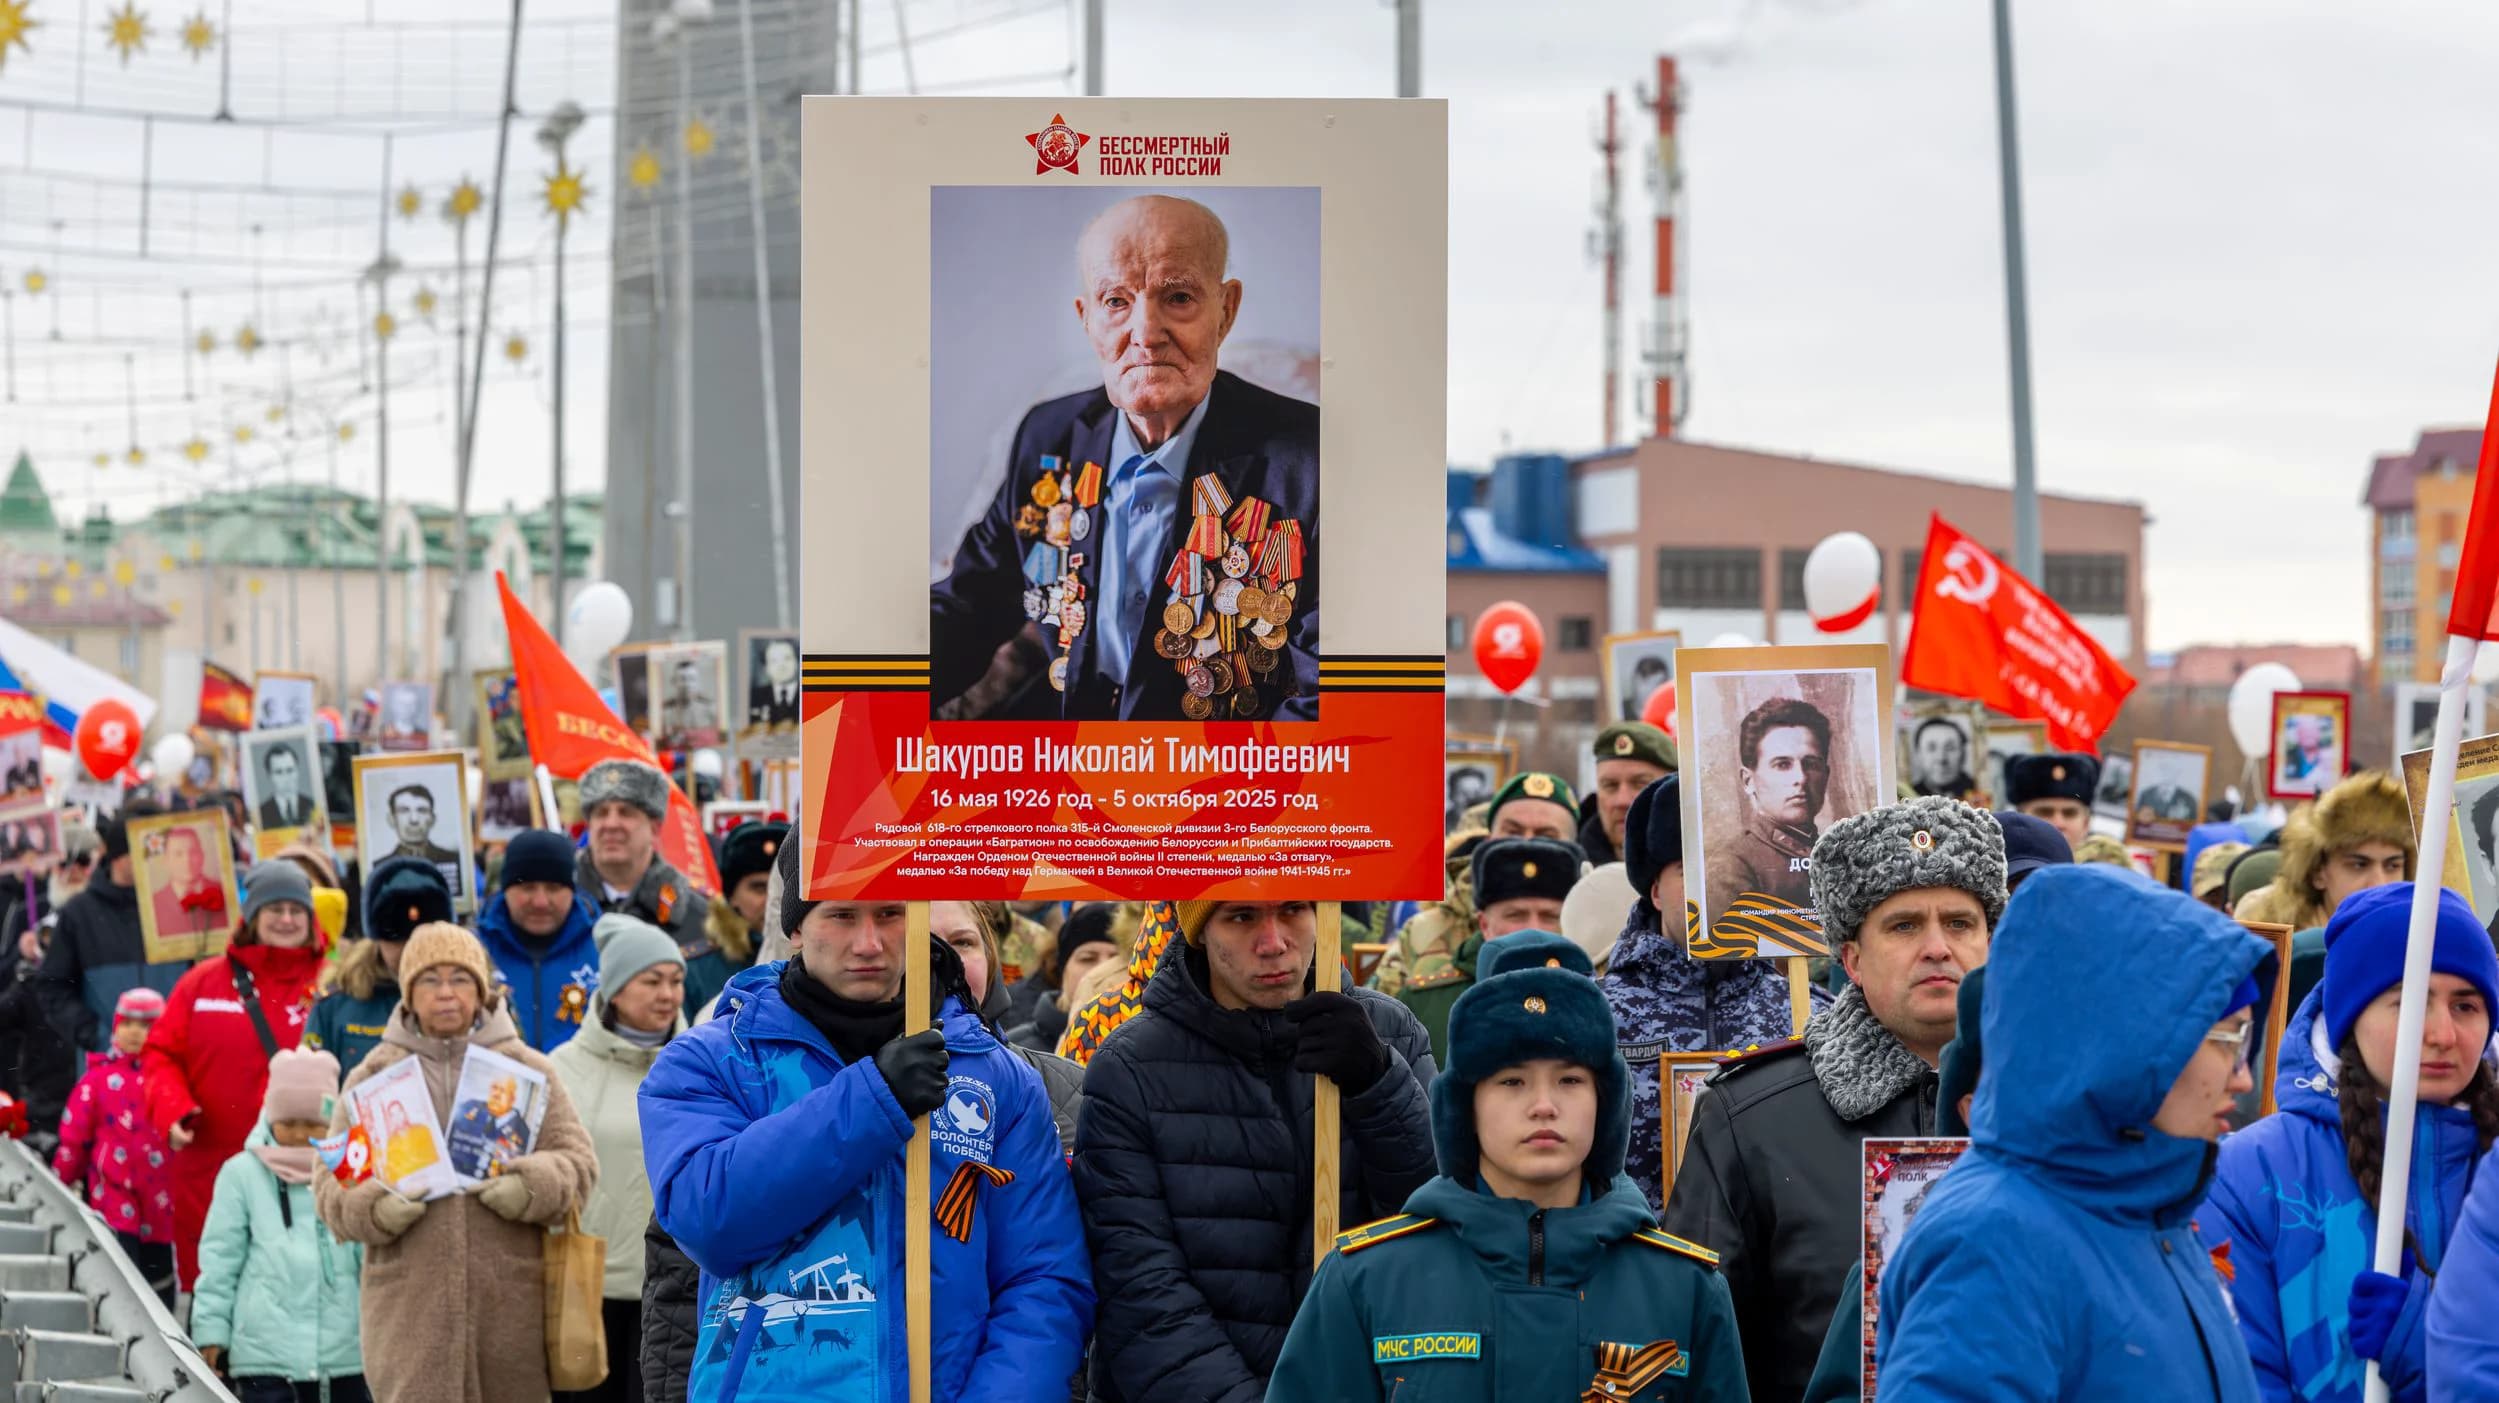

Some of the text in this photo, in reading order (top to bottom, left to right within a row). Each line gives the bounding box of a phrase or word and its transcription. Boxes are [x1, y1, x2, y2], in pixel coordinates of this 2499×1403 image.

[1100, 132, 1229, 155] БЕССМЕРТНЫЙ
[1100, 157, 1221, 176] ПОЛК РОССИИ
[896, 736, 1350, 780] Шакуров Николай Тимофеевич
[2477, 755, 2499, 765] меда
[930, 789, 953, 807] 16
[959, 793, 998, 807] мая
[1003, 788, 1051, 807] 1926
[1057, 793, 1093, 810] год
[1113, 789, 1126, 808] 5
[1132, 789, 1218, 812] октября
[1223, 789, 1277, 808] 2025
[1283, 793, 1319, 811] год
[875, 822, 1373, 835] Рядовой 618-го стрелкового полка 315-й Смоленской дивизии 3-го Белорусского фронта.
[854, 837, 917, 848] Участвовал
[919, 839, 926, 847] в
[928, 839, 983, 849] операции
[1058, 839, 1072, 847] по
[1074, 837, 1160, 849] освобождению
[1161, 837, 1229, 849] Белоруссии
[1231, 839, 1239, 847] и
[1241, 837, 1328, 849] Прибалтийских
[1329, 839, 1393, 850] государств.
[913, 851, 975, 863] Награжден
[977, 851, 1029, 863] Орденом
[1031, 851, 1117, 862] Отечественной
[1119, 851, 1155, 862] войны
[1157, 851, 1164, 861] II
[1166, 853, 1215, 862] степени,
[1217, 853, 1267, 863] медалью
[1789, 857, 1811, 873] ДО
[896, 868, 946, 877] медалью
[970, 865, 1010, 878] победу
[1012, 865, 1033, 878] над
[1033, 865, 1095, 877] Германией
[1097, 868, 1104, 876] в
[1106, 865, 1154, 877] Великой
[1155, 865, 1242, 877] Отечественной
[1244, 865, 1279, 877] войне
[1280, 865, 1331, 877] 1941-1945
[1740, 907, 1817, 916] КОМАНДИР МИНОМЕТНО
[931, 1130, 993, 1154] ВОЛОНТЁР
[943, 1143, 989, 1164] ПОБЕДЫ
[1897, 1172, 1928, 1182] ПОЛК
[1378, 1336, 1476, 1358] МЧС РОССИИ
